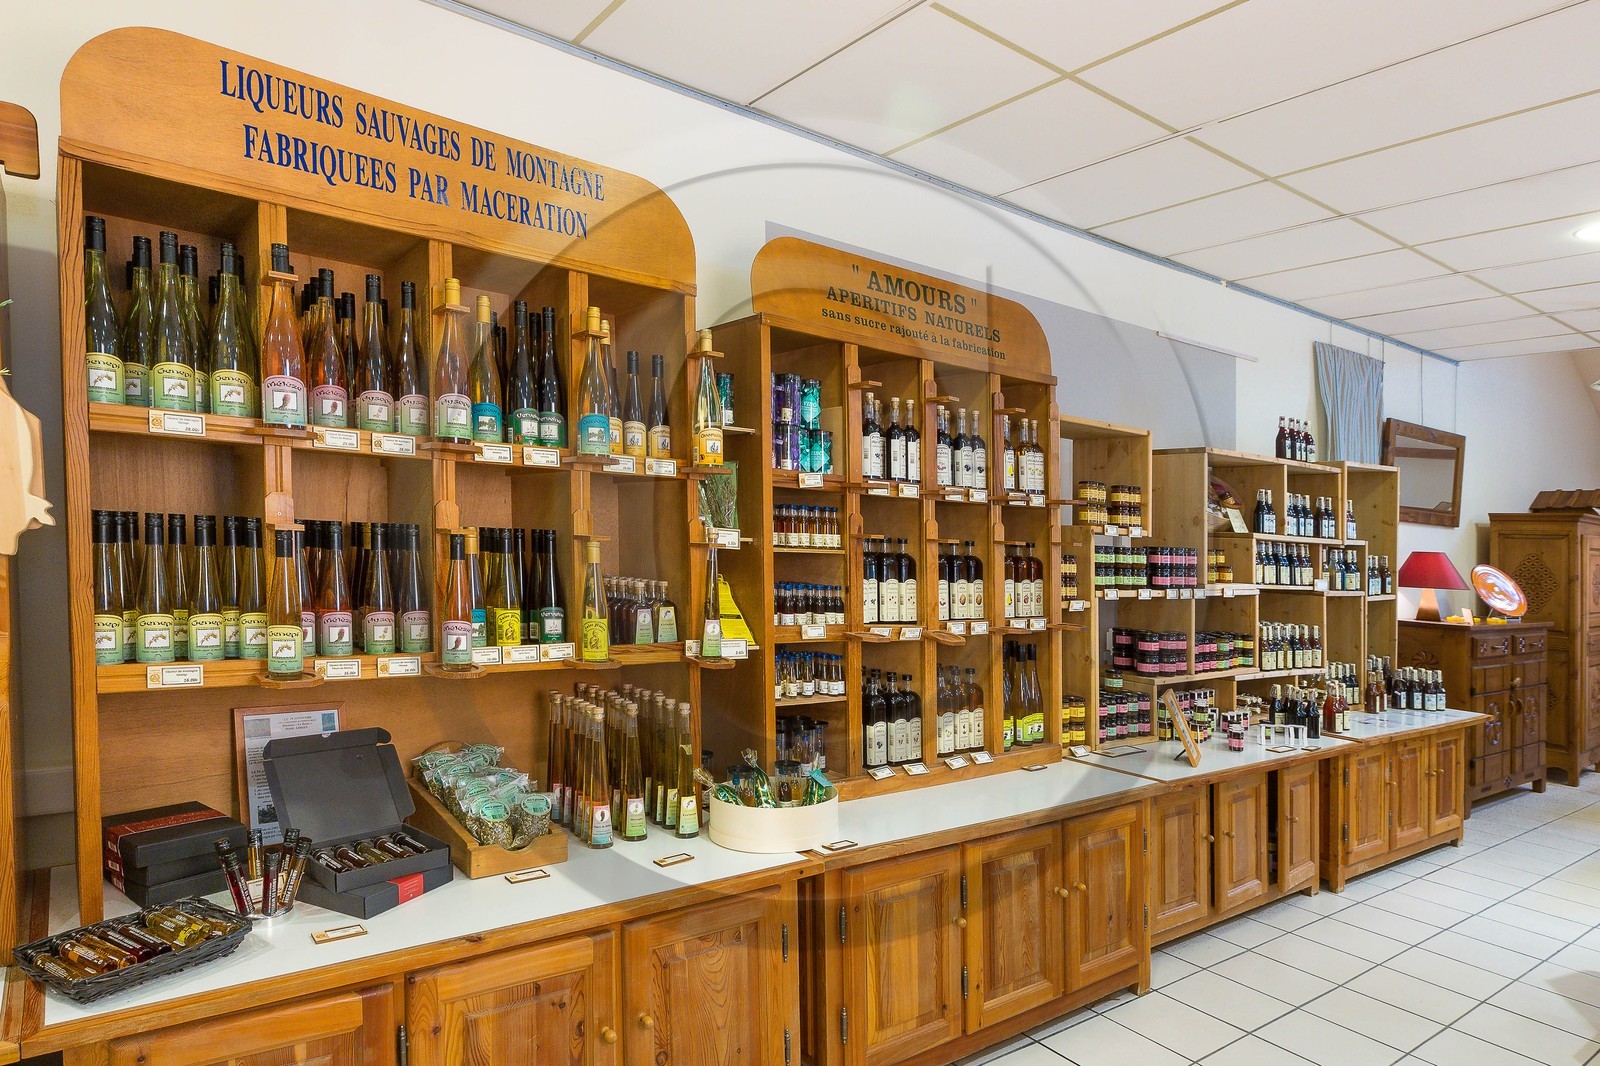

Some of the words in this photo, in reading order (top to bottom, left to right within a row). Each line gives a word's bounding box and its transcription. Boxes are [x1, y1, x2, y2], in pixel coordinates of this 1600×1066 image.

[220, 60, 343, 128] LIQUEURS
[356, 102, 460, 162] SAUVAGES
[471, 137, 496, 172] DE
[506, 147, 604, 201] MONTAGNE
[243, 124, 397, 193] FABRIQUEES
[408, 168, 450, 206] PAR
[460, 181, 588, 240] MACERATION
[826, 286, 917, 321] APERITIFS
[925, 311, 1000, 342] NATURELS
[867, 271, 966, 314] AMOURS
[822, 308, 851, 322] sans
[855, 316, 886, 330] sucre
[890, 325, 928, 340] rajouté
[932, 332, 937, 343] à
[940, 335, 950, 346] la
[952, 338, 1005, 360] fabrication
